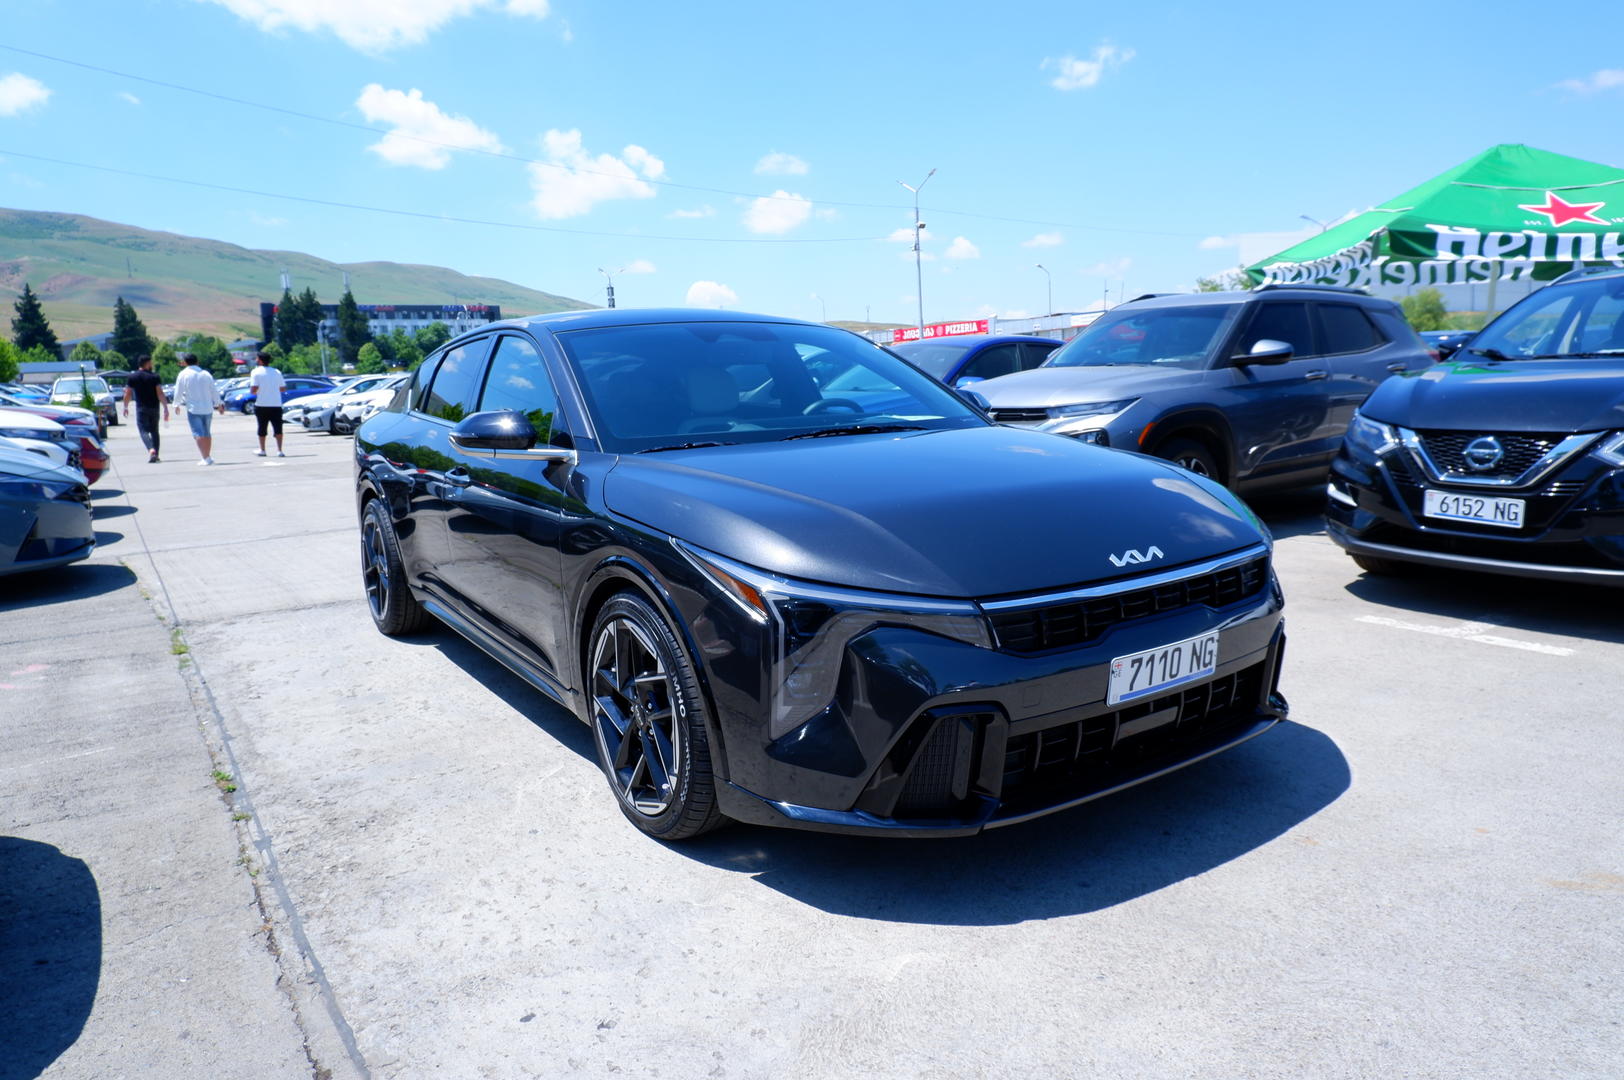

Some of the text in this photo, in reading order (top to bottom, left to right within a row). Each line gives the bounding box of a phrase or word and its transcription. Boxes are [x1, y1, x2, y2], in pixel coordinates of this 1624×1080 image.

[945, 322, 978, 335] PIZZERIA
[1440, 496, 1519, 521] 6152 NG
[1109, 545, 1164, 567] KIA
[1129, 637, 1215, 691] 7110 NG
